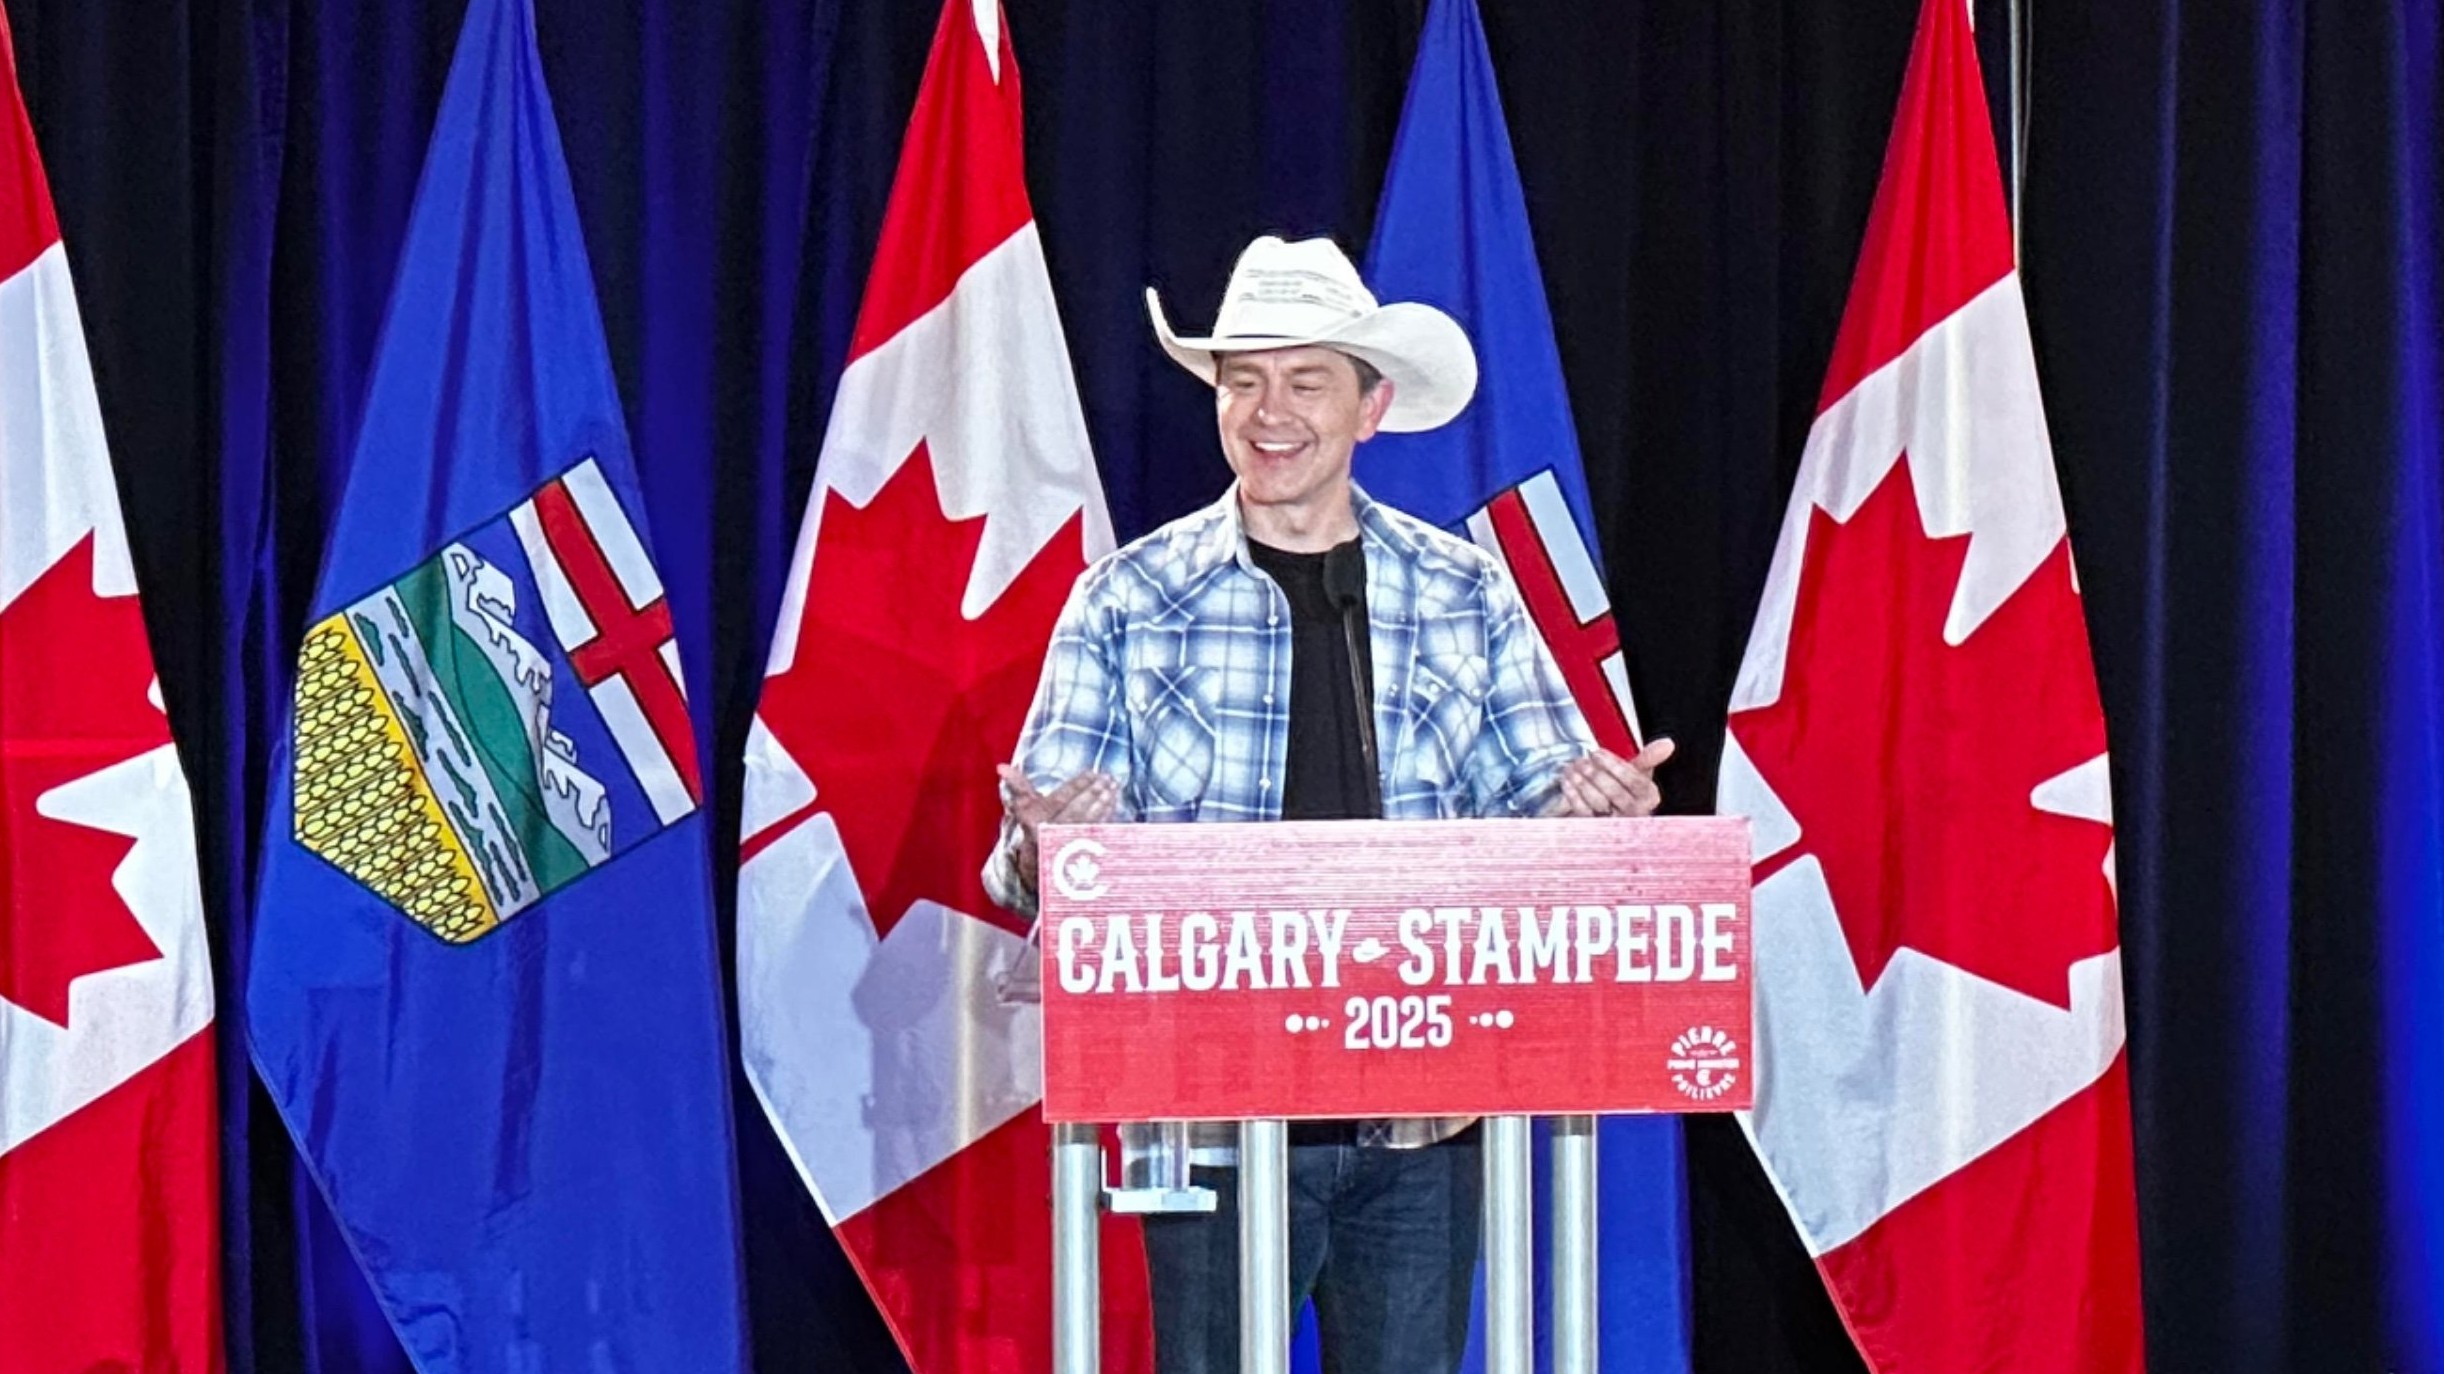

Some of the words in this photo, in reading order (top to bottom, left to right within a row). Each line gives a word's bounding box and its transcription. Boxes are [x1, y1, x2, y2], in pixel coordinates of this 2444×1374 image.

[1058, 911, 1350, 993] CALGARY
[1397, 905, 1737, 985] STAMPEDE
[1344, 996, 1452, 1049] 2025
